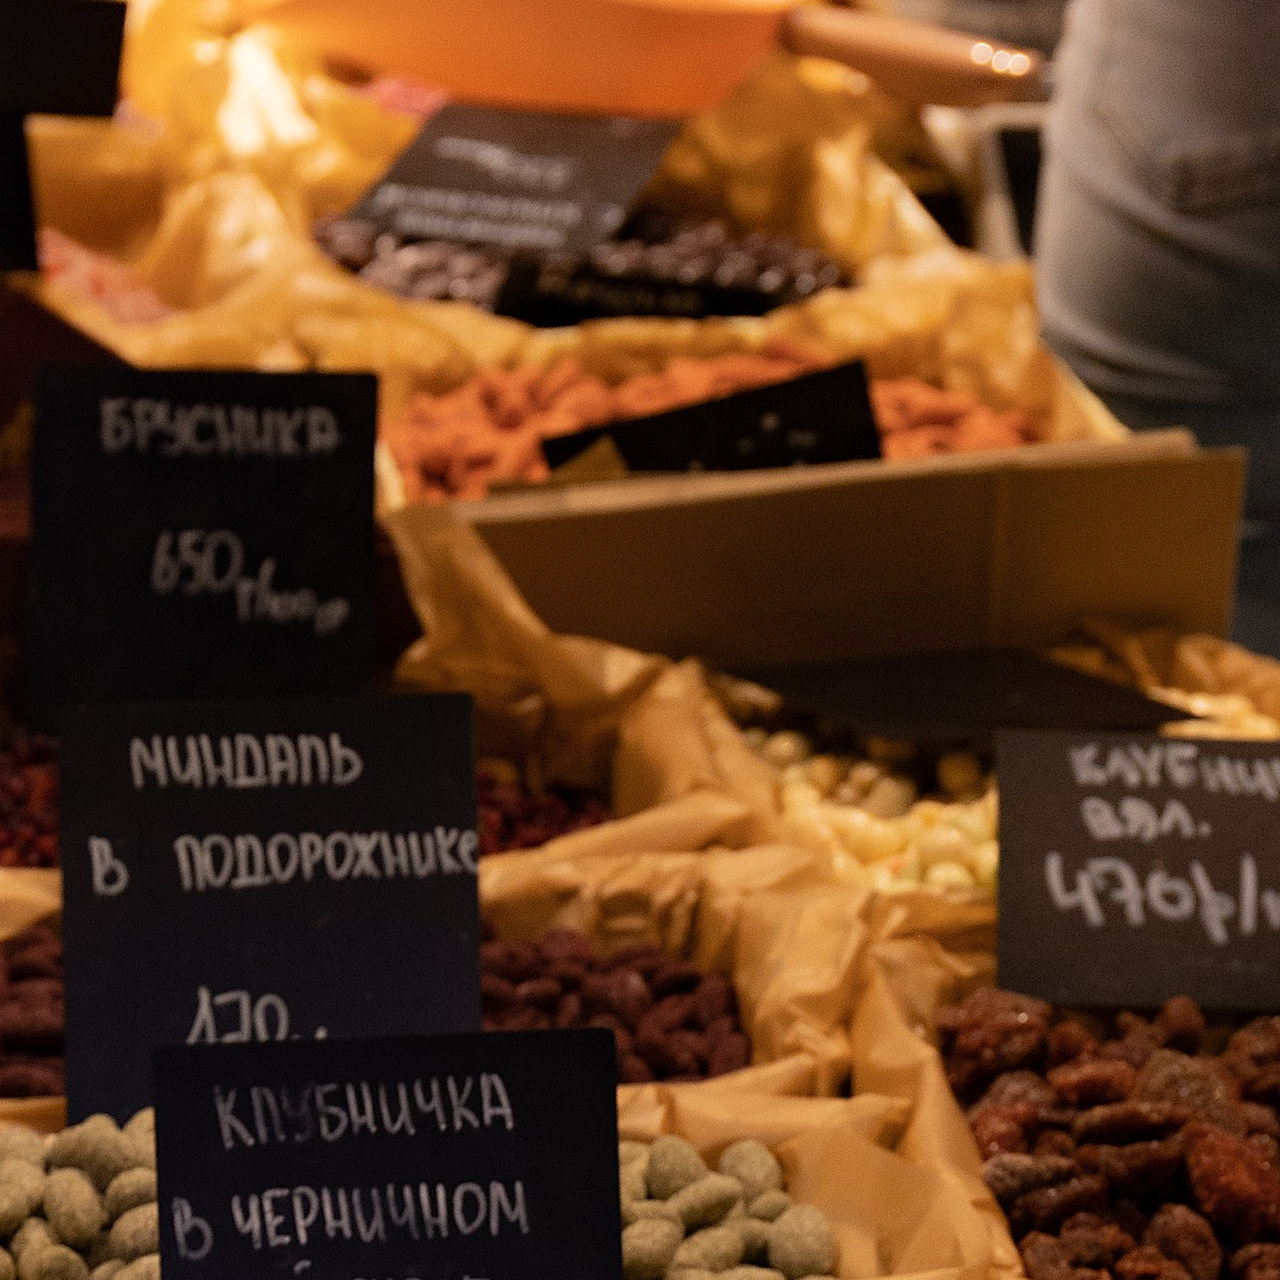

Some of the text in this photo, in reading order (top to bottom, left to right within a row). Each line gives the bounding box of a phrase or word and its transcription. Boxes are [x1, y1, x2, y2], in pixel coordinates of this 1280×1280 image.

[100, 398, 340, 454] БРУСНИКА
[131, 733, 362, 787] МИНДАЛЬ
[89, 837, 128, 894] В
[216, 1073, 514, 1149] КЛУБНИЧКА
[173, 1181, 528, 1259] В ЧЕРНИЧНОМ
